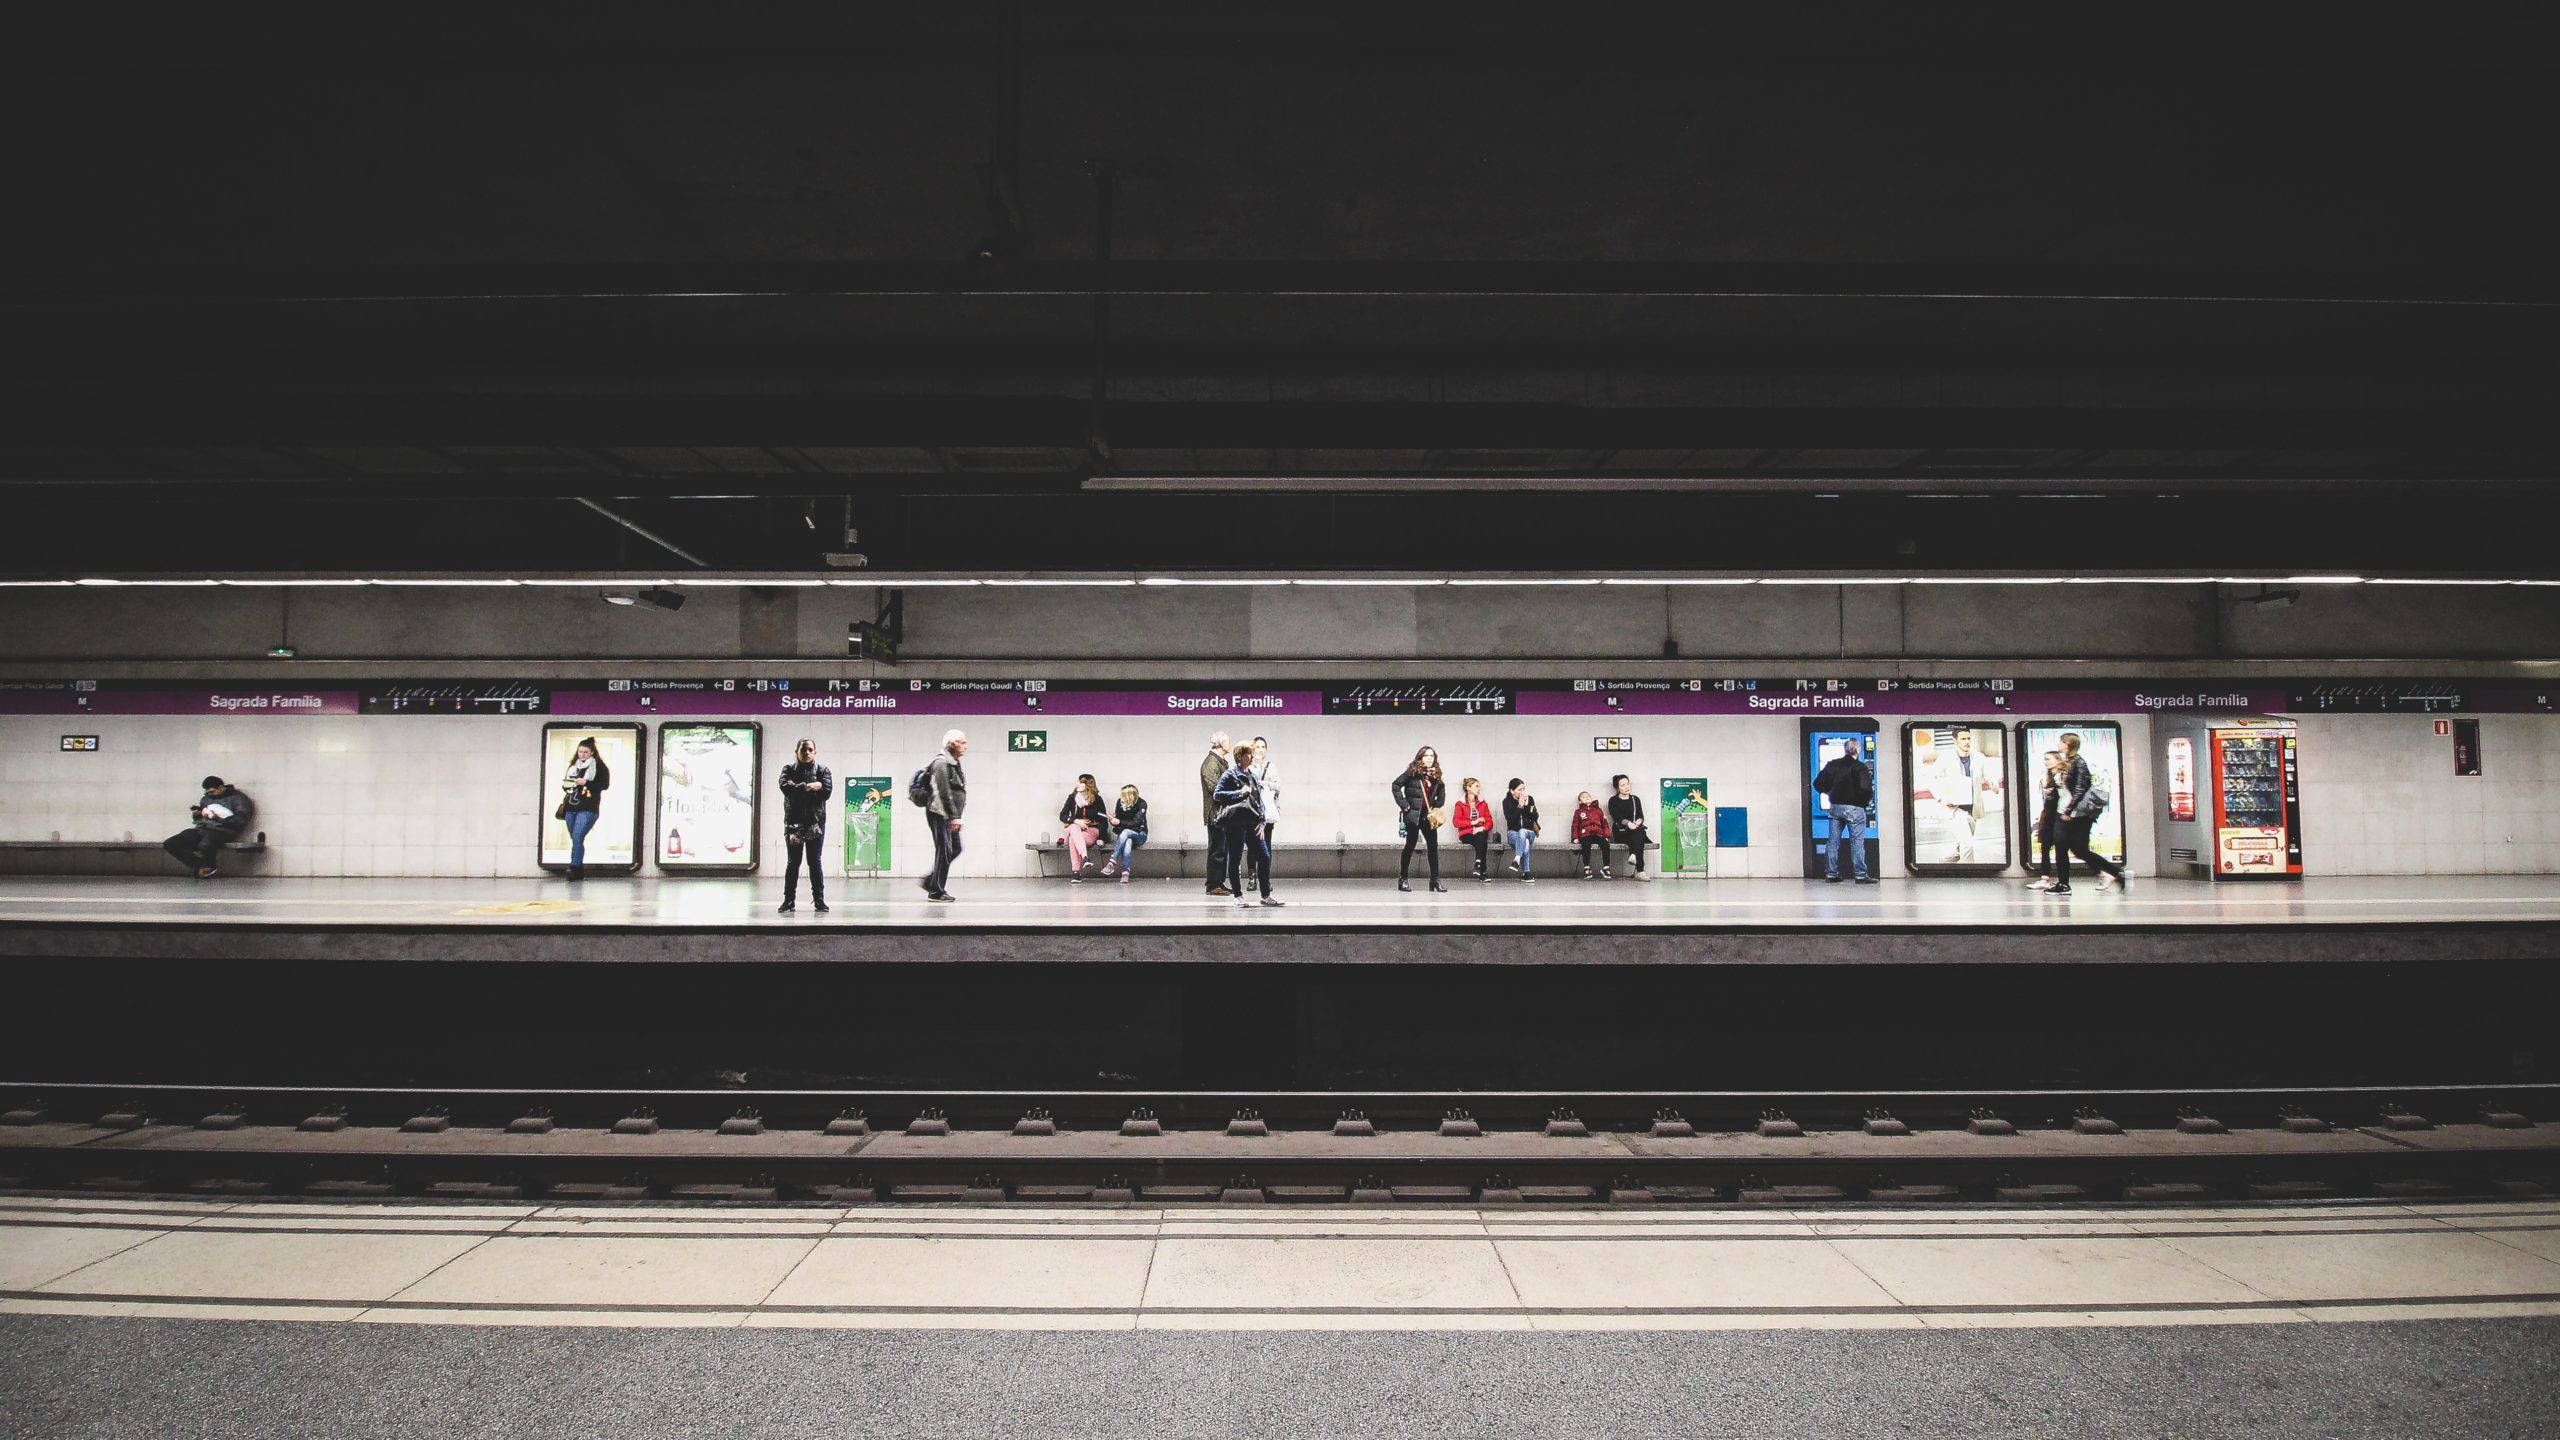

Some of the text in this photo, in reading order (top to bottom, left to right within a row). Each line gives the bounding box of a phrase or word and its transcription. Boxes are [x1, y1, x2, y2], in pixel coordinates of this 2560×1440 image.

[670, 682, 704, 690] Provença
[941, 682, 1012, 691] Sortida Plaça Gaudí
[1636, 682, 1670, 690] Provença
[1937, 682, 1956, 690] Plaça
[1958, 681, 1980, 689] Gaudí
[210, 695, 322, 710] Sagrada Família
[641, 697, 651, 705] M
[781, 695, 895, 711] Sagrada Família
[1027, 698, 1037, 706] M
[1168, 695, 1282, 711] Sagrada Família
[1607, 697, 1617, 705] M
[1749, 694, 1864, 710] Sagrada Família
[2134, 693, 2248, 708] Sagrada Família
